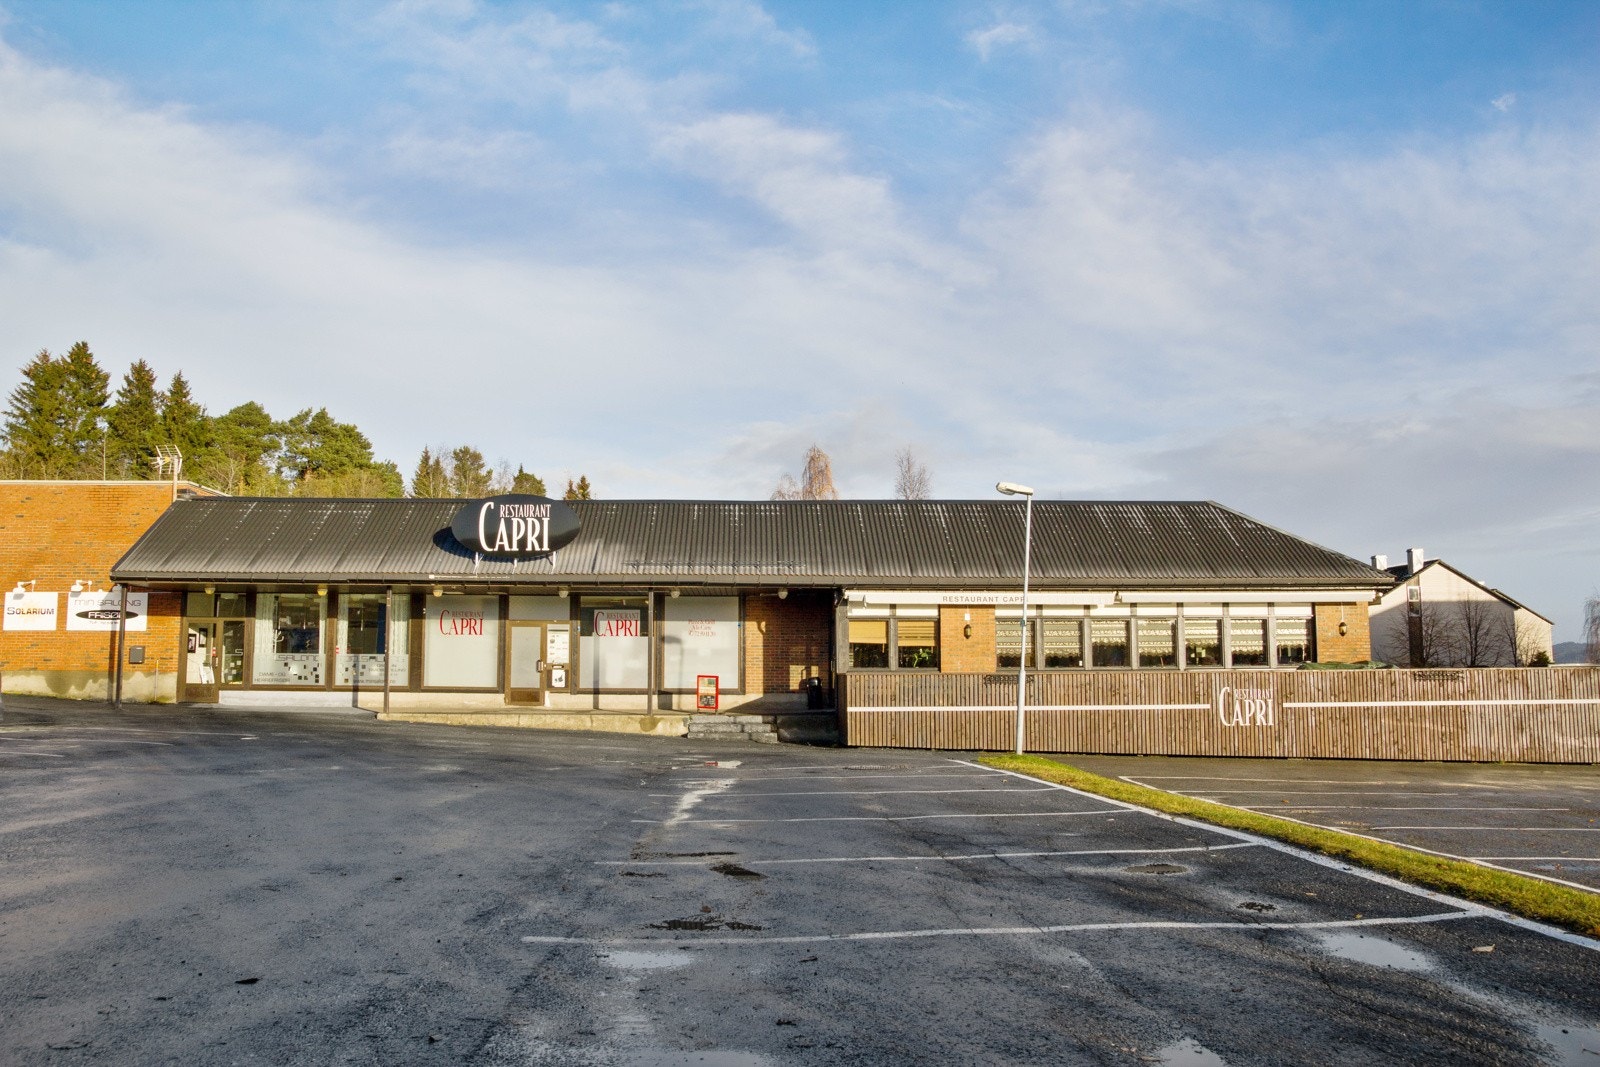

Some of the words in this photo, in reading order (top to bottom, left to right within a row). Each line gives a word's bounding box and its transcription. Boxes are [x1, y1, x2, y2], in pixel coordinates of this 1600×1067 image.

[500, 504, 551, 517] RESTAURANT
[479, 501, 550, 552] CAPRI
[7, 606, 55, 615] SOLARIUM
[88, 611, 121, 619] FRISØ
[439, 609, 484, 635] CAPRI
[594, 611, 639, 636] CAPRI
[1235, 688, 1274, 699] RESTAURANT
[1219, 686, 1274, 726] CAPRI
